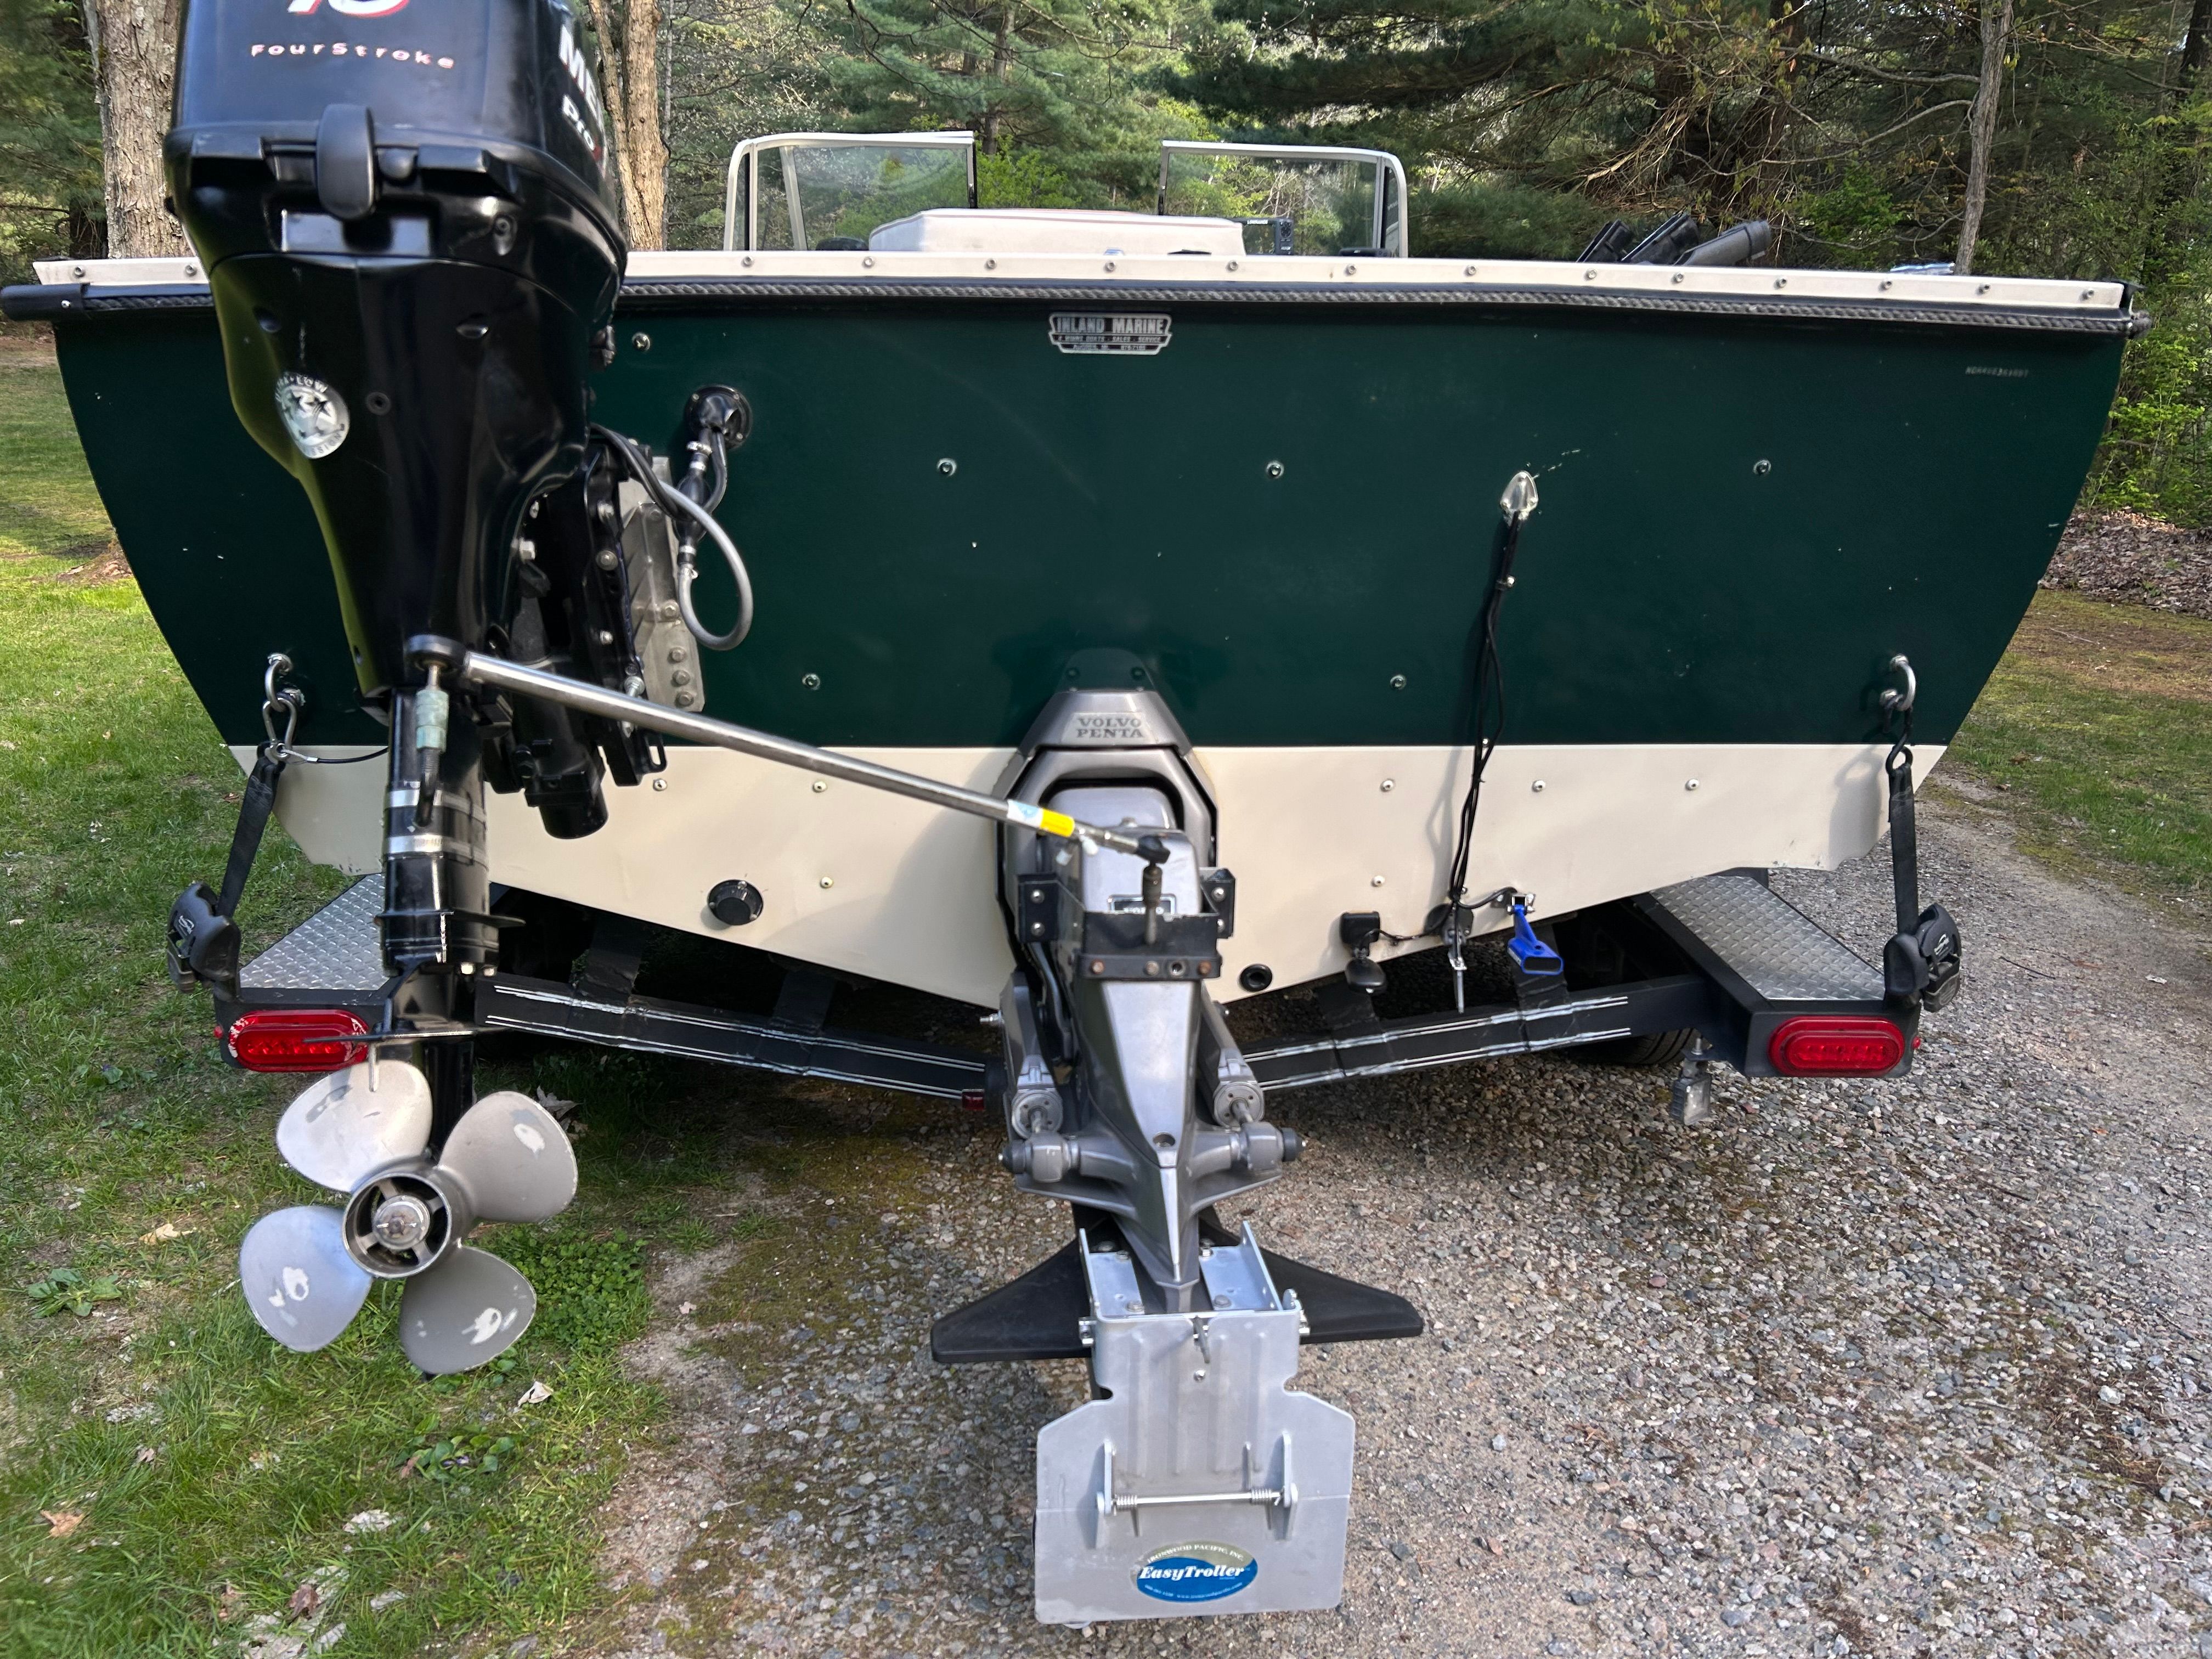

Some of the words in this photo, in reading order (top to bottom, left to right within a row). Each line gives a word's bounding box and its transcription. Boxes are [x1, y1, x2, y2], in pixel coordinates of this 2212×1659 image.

[250, 42, 454, 70] FourStroke
[1056, 317, 1105, 334] INLAND
[1113, 318, 1165, 335] MARINE
[1078, 718, 1142, 728] VOLVO
[1076, 729, 1143, 738] PENTA
[1147, 1544, 1193, 1564] IRONWOOD
[1138, 1564, 1245, 1582] EasyTroller
